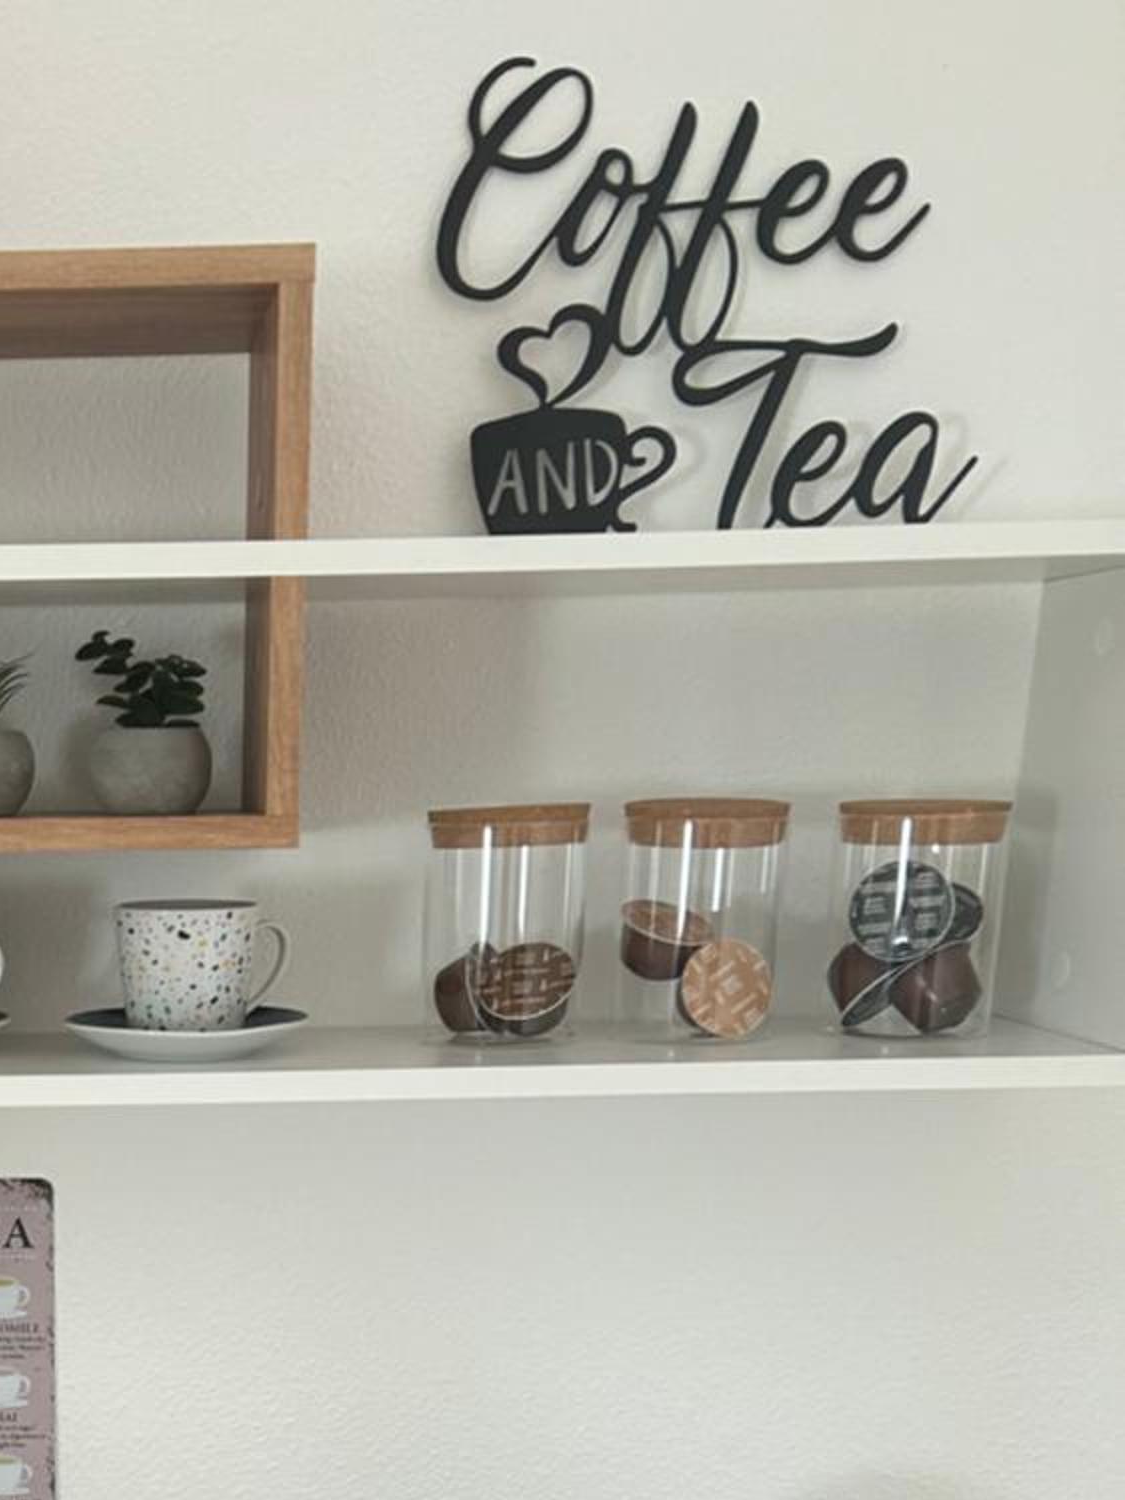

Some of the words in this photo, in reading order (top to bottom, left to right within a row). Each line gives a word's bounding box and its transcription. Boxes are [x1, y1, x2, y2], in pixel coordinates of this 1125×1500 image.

[436, 57, 931, 357] Coffee
[487, 439, 619, 517] AND
[671, 321, 979, 531] Tea
